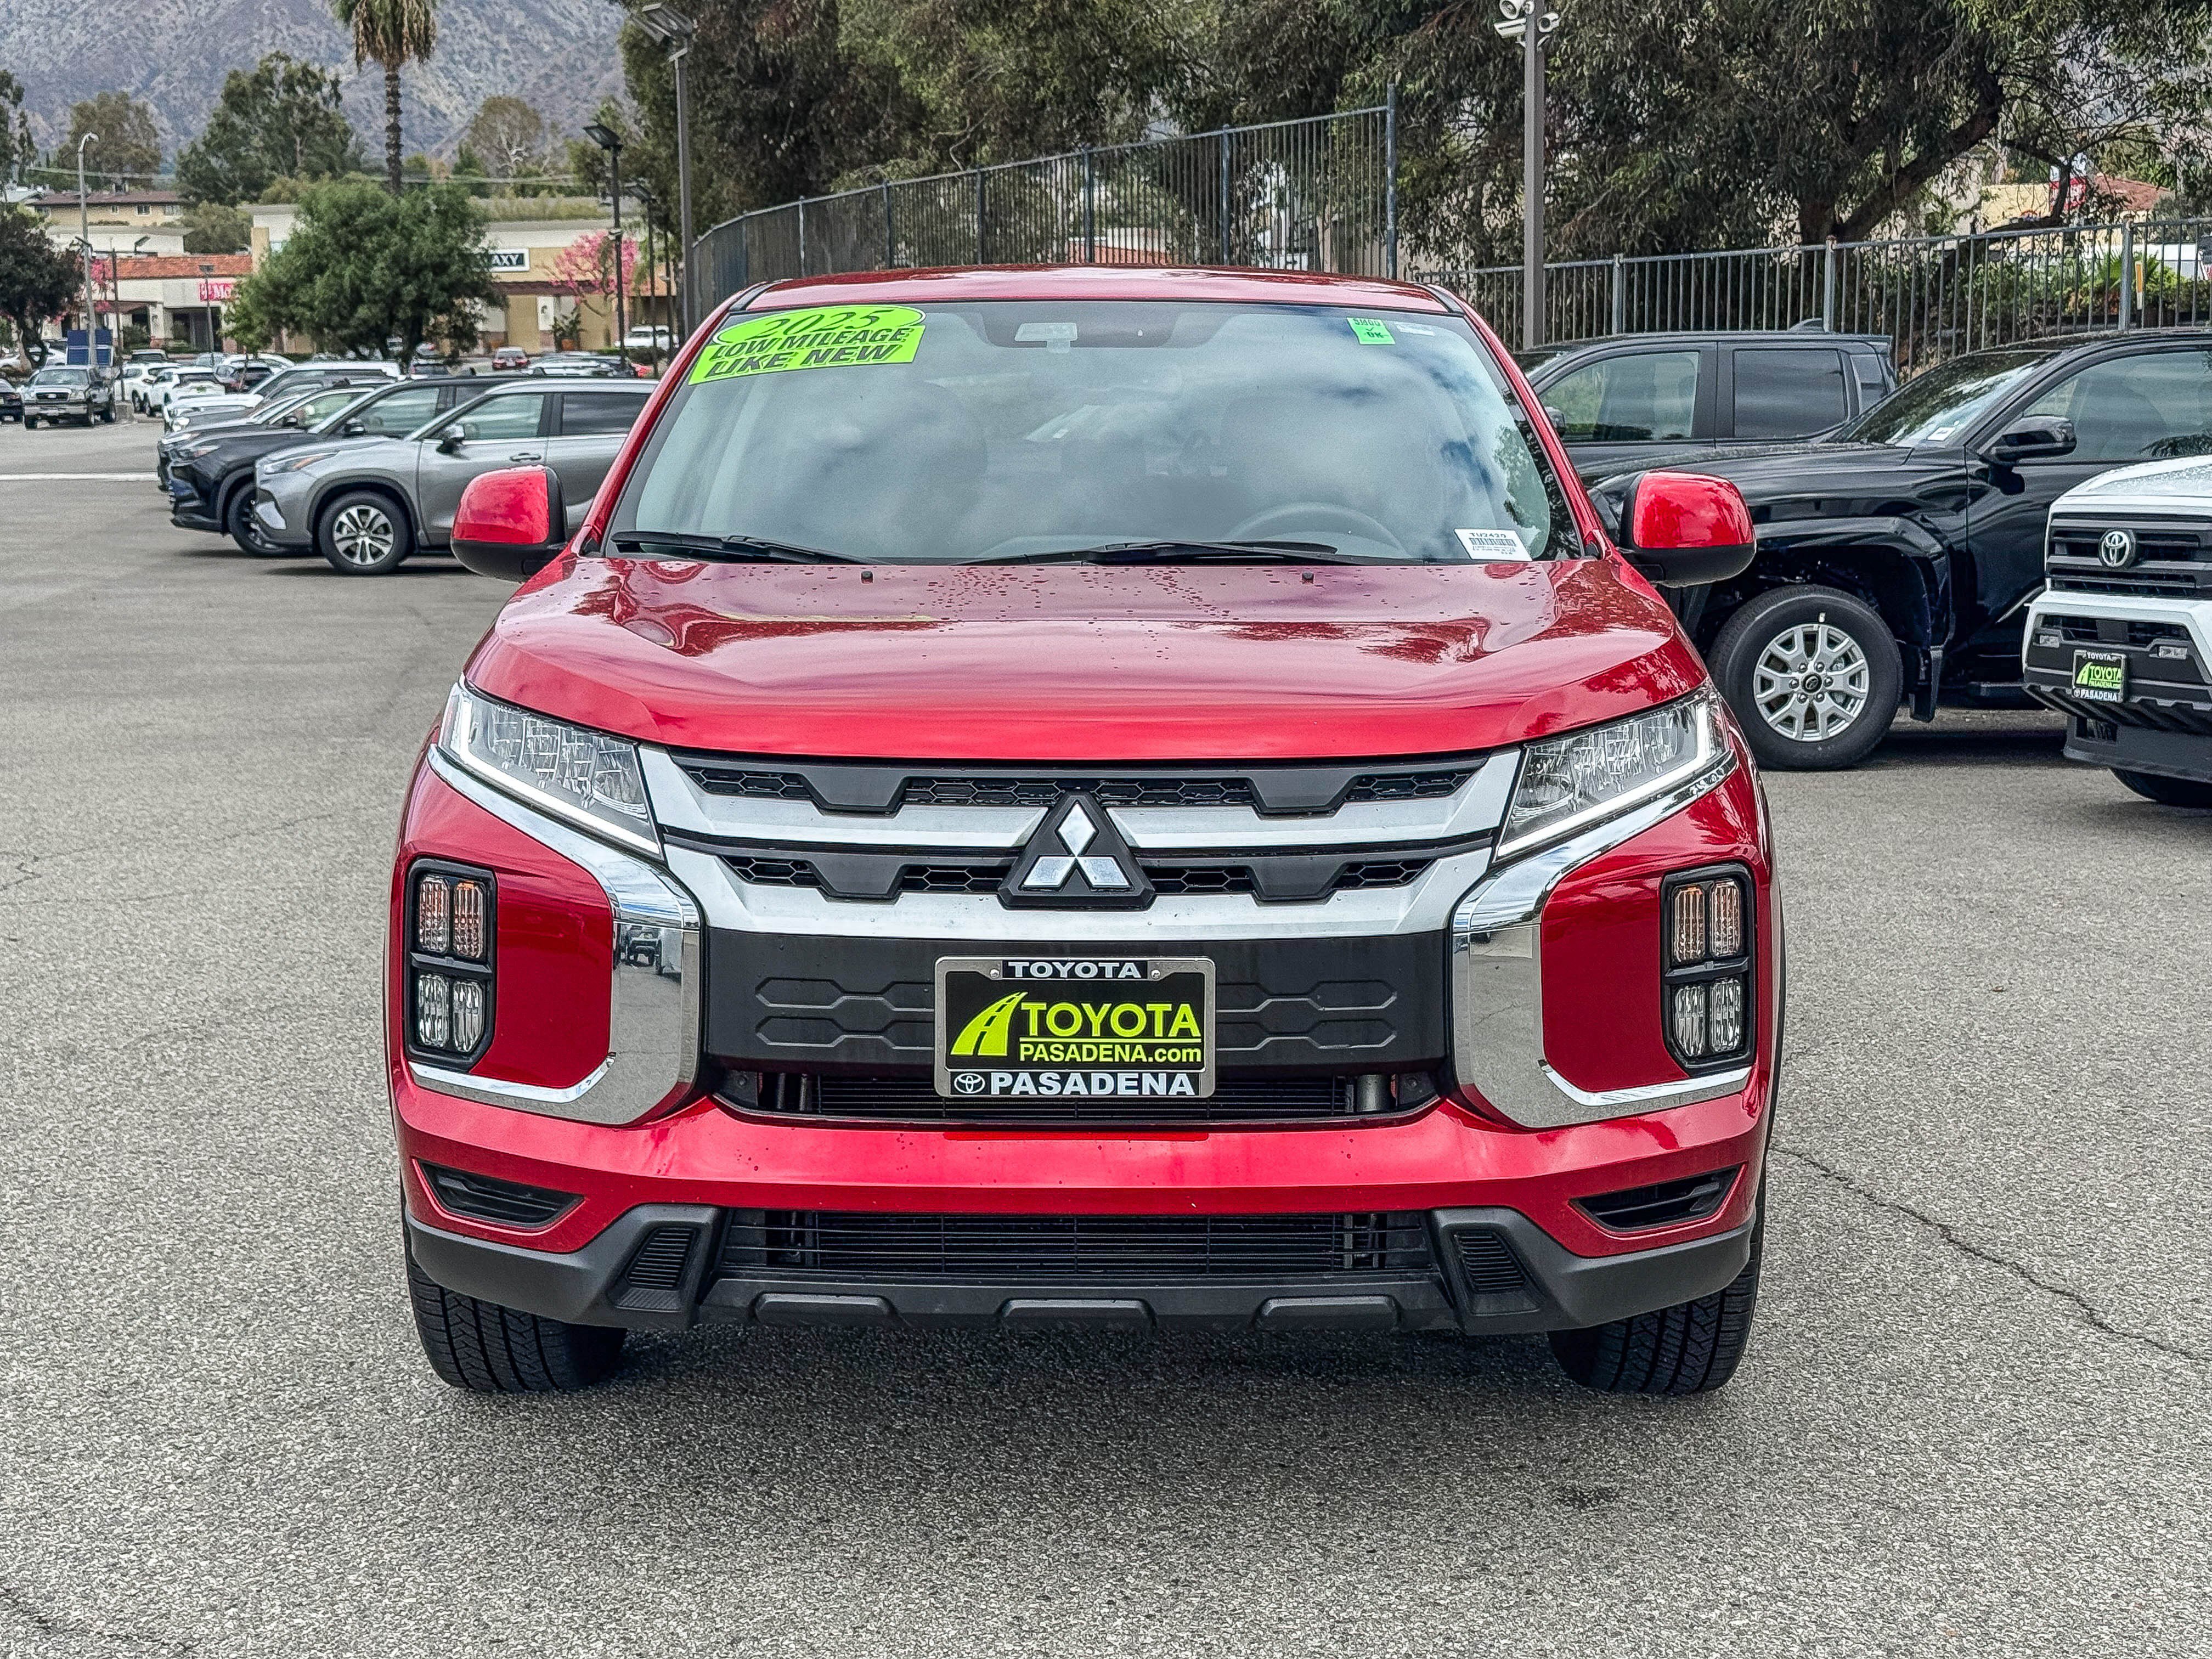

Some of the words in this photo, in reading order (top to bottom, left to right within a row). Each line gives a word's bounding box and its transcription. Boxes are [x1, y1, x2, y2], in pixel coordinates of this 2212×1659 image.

[492, 254, 519, 266] AXY
[744, 309, 894, 341] 2025
[709, 337, 780, 360] LOW
[778, 328, 914, 351] MILEAGE
[704, 352, 797, 379] LIKE
[799, 345, 902, 366] NEW
[2087, 652, 2112, 661] TOYOTA
[2090, 665, 2121, 680] TOYOTA
[2080, 689, 2117, 701] PASADENA
[1008, 962, 1142, 978] TOYOTA
[1020, 1002, 1201, 1037] TOYOTA
[1019, 1043, 1201, 1063] PASADENA.com
[990, 1072, 1196, 1096] PASADENA
